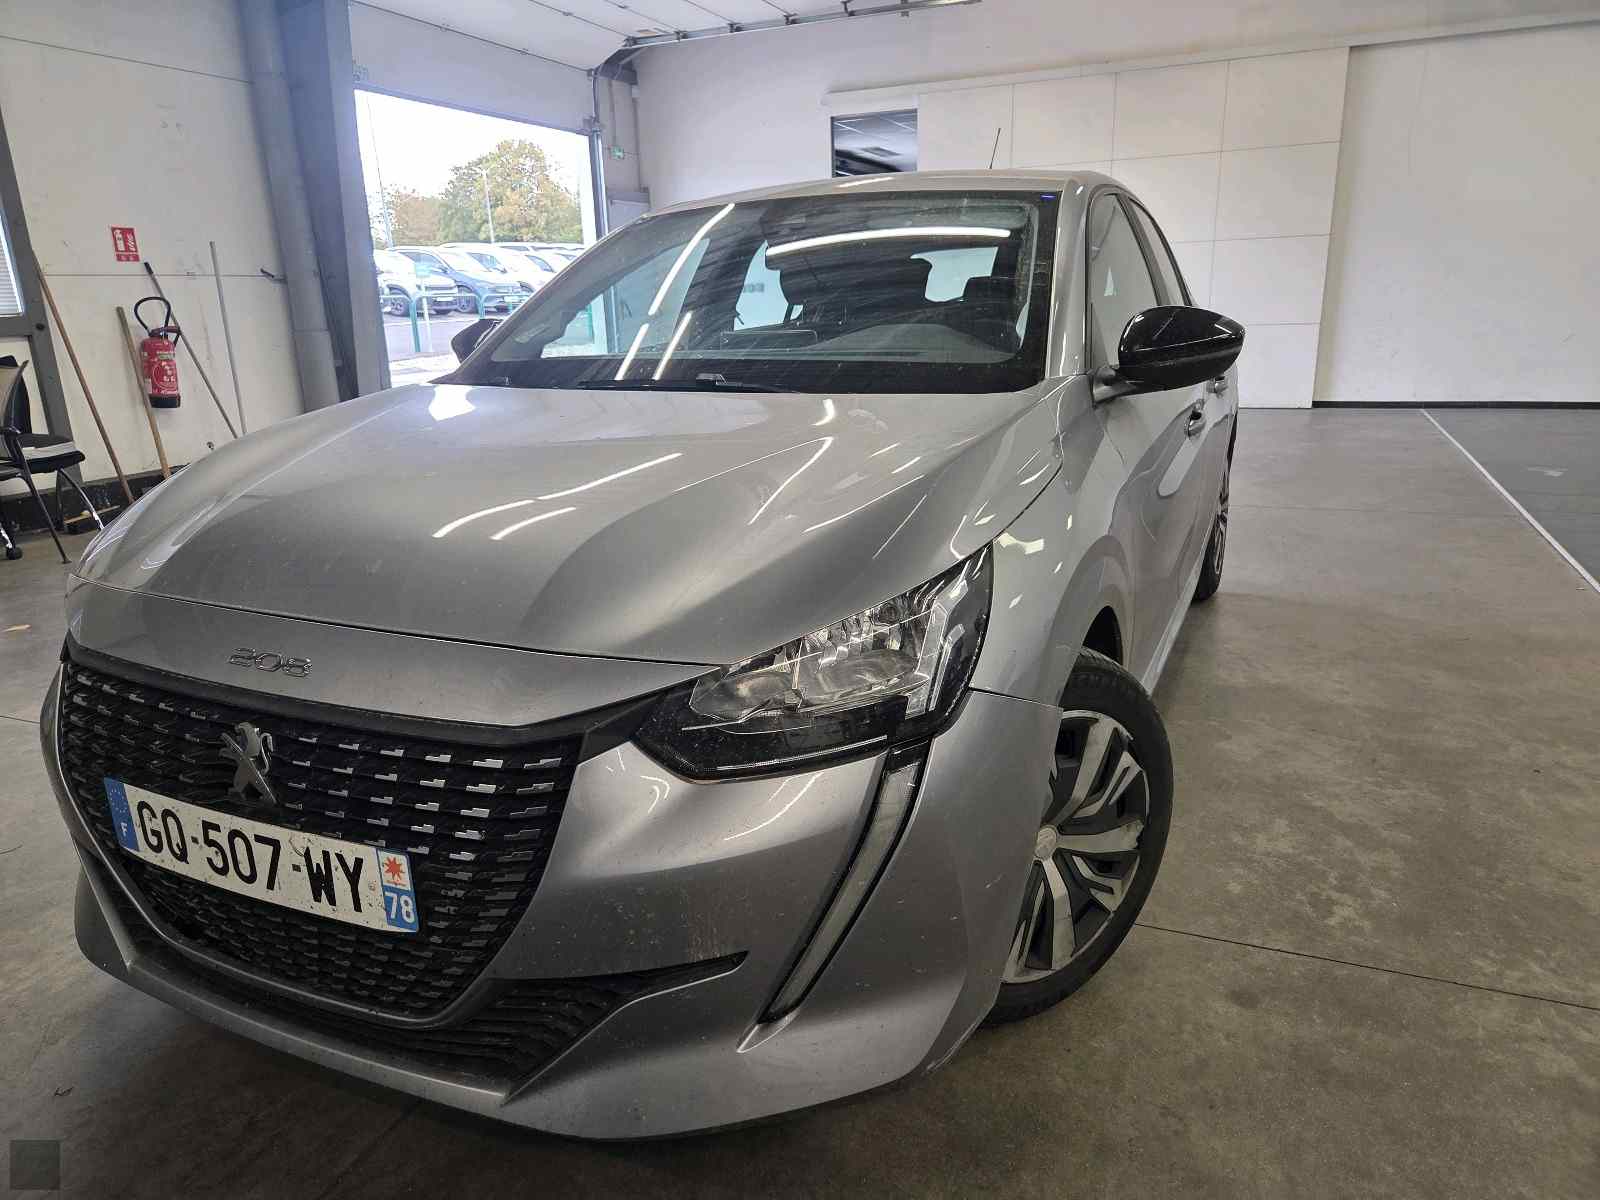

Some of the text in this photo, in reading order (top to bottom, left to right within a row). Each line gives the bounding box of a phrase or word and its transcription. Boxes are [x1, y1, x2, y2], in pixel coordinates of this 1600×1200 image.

[228, 648, 312, 677] 208
[137, 801, 363, 912] GQ-507-WY
[385, 891, 415, 923] 78
